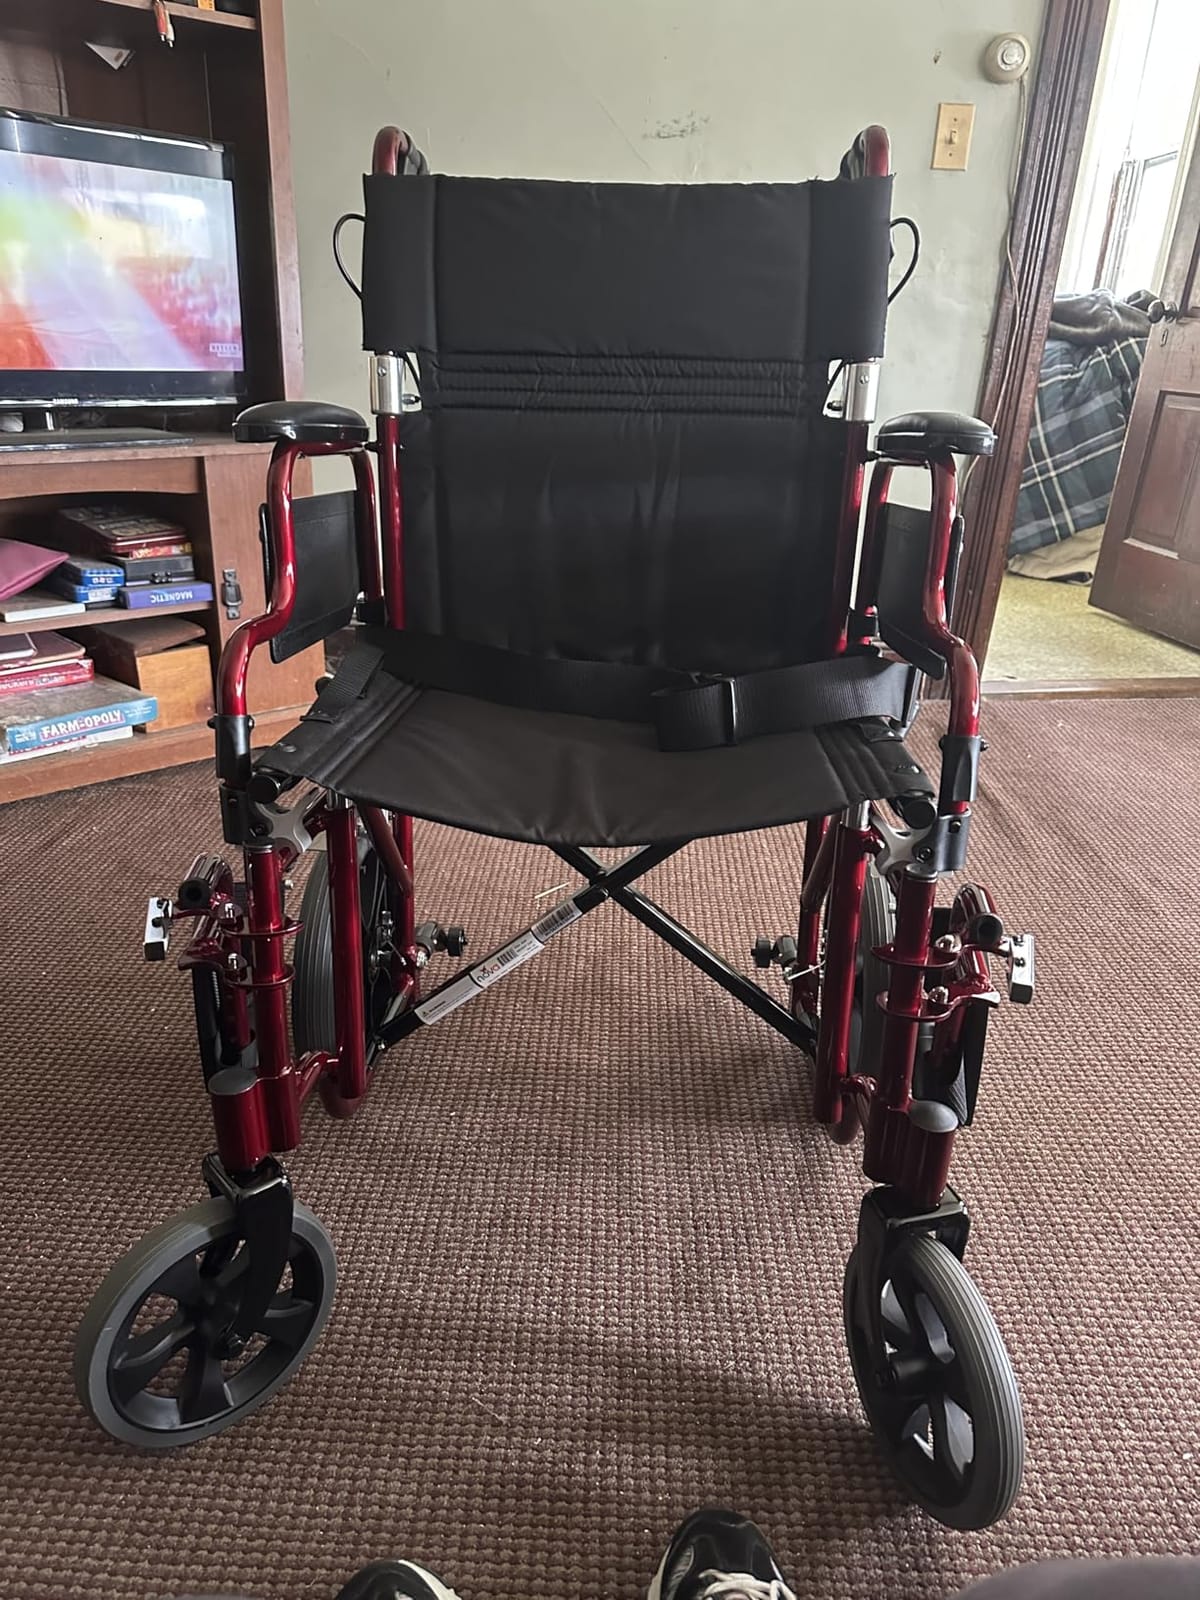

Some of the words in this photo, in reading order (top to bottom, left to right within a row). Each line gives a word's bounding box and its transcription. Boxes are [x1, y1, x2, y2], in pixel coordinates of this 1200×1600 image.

[150, 590, 193, 603] MAGNETIC
[41, 709, 122, 739] FARM-OPOLY
[476, 963, 500, 982] nova
